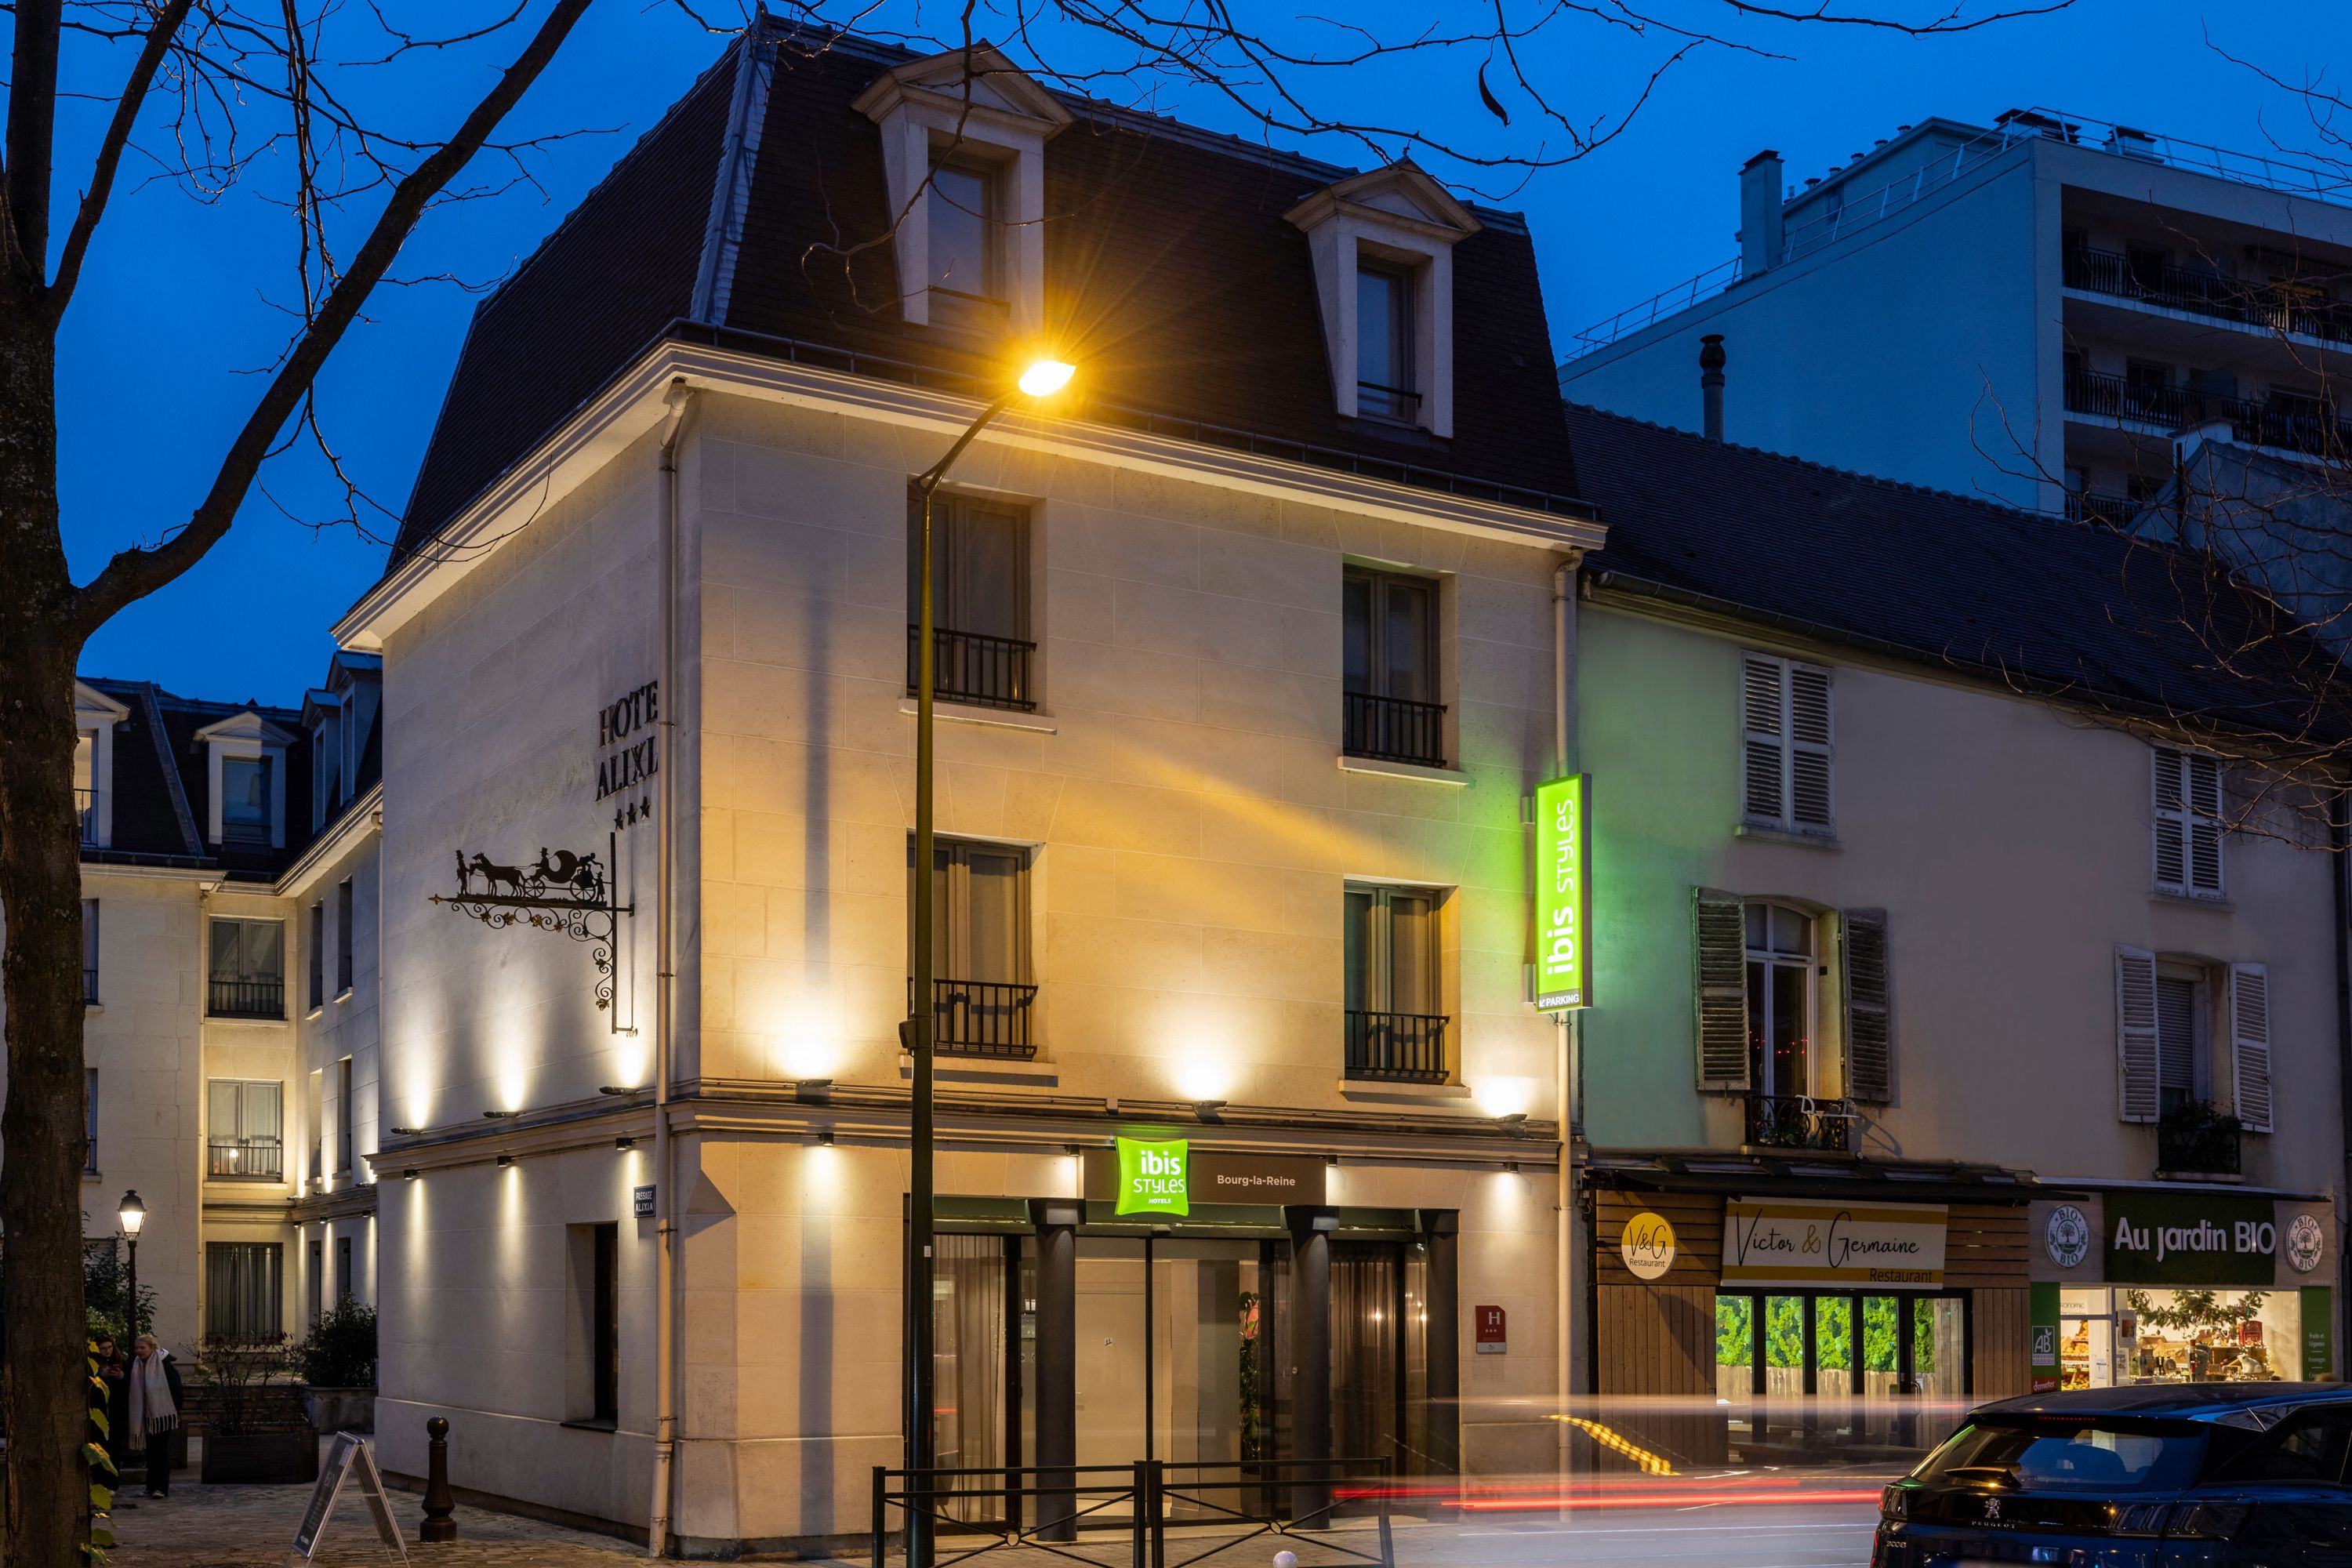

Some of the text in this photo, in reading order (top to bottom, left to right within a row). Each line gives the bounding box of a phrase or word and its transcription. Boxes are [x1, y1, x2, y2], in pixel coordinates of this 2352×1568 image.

[1547, 906, 1573, 975] ibis
[1545, 993, 1579, 1007] PARKING
[1140, 1150, 1181, 1175] ibis
[1217, 1174, 1296, 1187] Bourg-la-Reine
[635, 1202, 653, 1212] ALIXIA
[2058, 1208, 2078, 1221] BIO
[2296, 1216, 2314, 1229] BIO
[1629, 1224, 1667, 1259] V&G
[1736, 1207, 1920, 1269] Victor & Germaine
[2114, 1217, 2277, 1262] Au jardin BIO
[1629, 1258, 1665, 1268] Restaurant
[2060, 1253, 2078, 1265] BIO
[2299, 1258, 2314, 1269] BIO
[1869, 1268, 1933, 1283] Restaurant
[1488, 1312, 1501, 1325] H
[2034, 1335, 2051, 1353] AB
[1971, 1520, 2016, 1529] PEUGEOT
